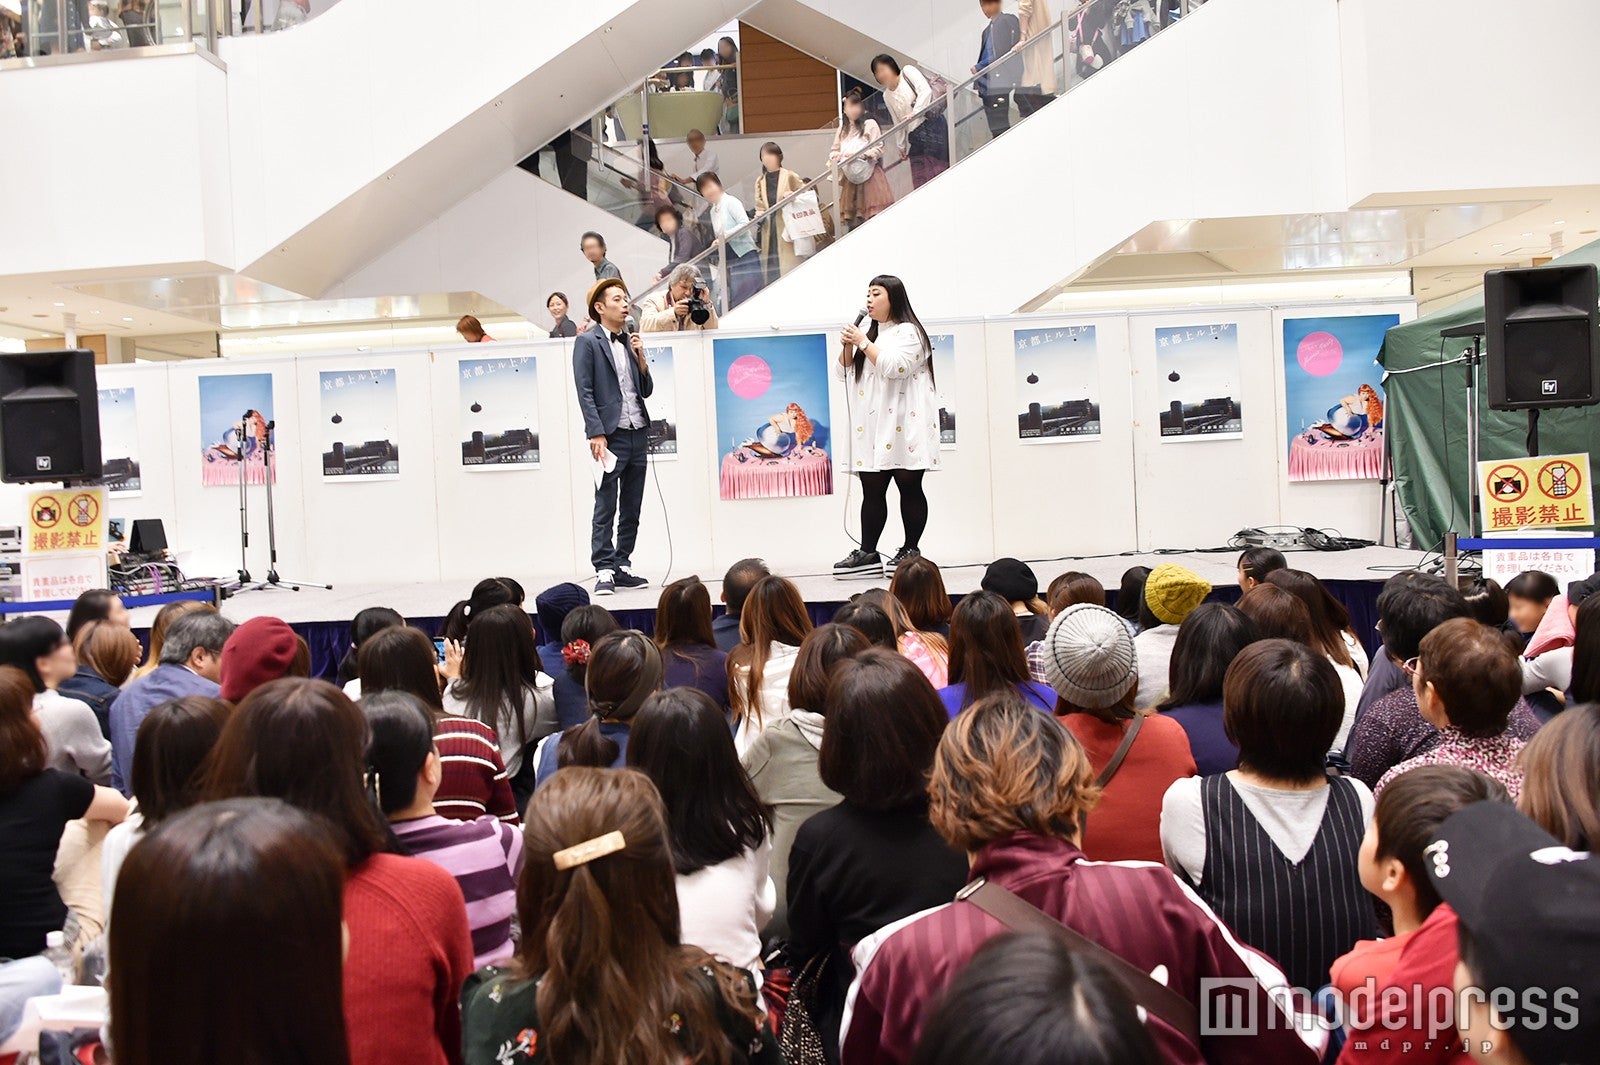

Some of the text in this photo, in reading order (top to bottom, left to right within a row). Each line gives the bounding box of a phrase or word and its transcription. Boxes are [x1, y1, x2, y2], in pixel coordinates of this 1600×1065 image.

[1018, 325, 1088, 349] 京都上ル上ル
[1492, 503, 1584, 527] 撮影禁止
[33, 530, 98, 550] 撮影禁止
[1496, 552, 1575, 562] 貴重品は各自で
